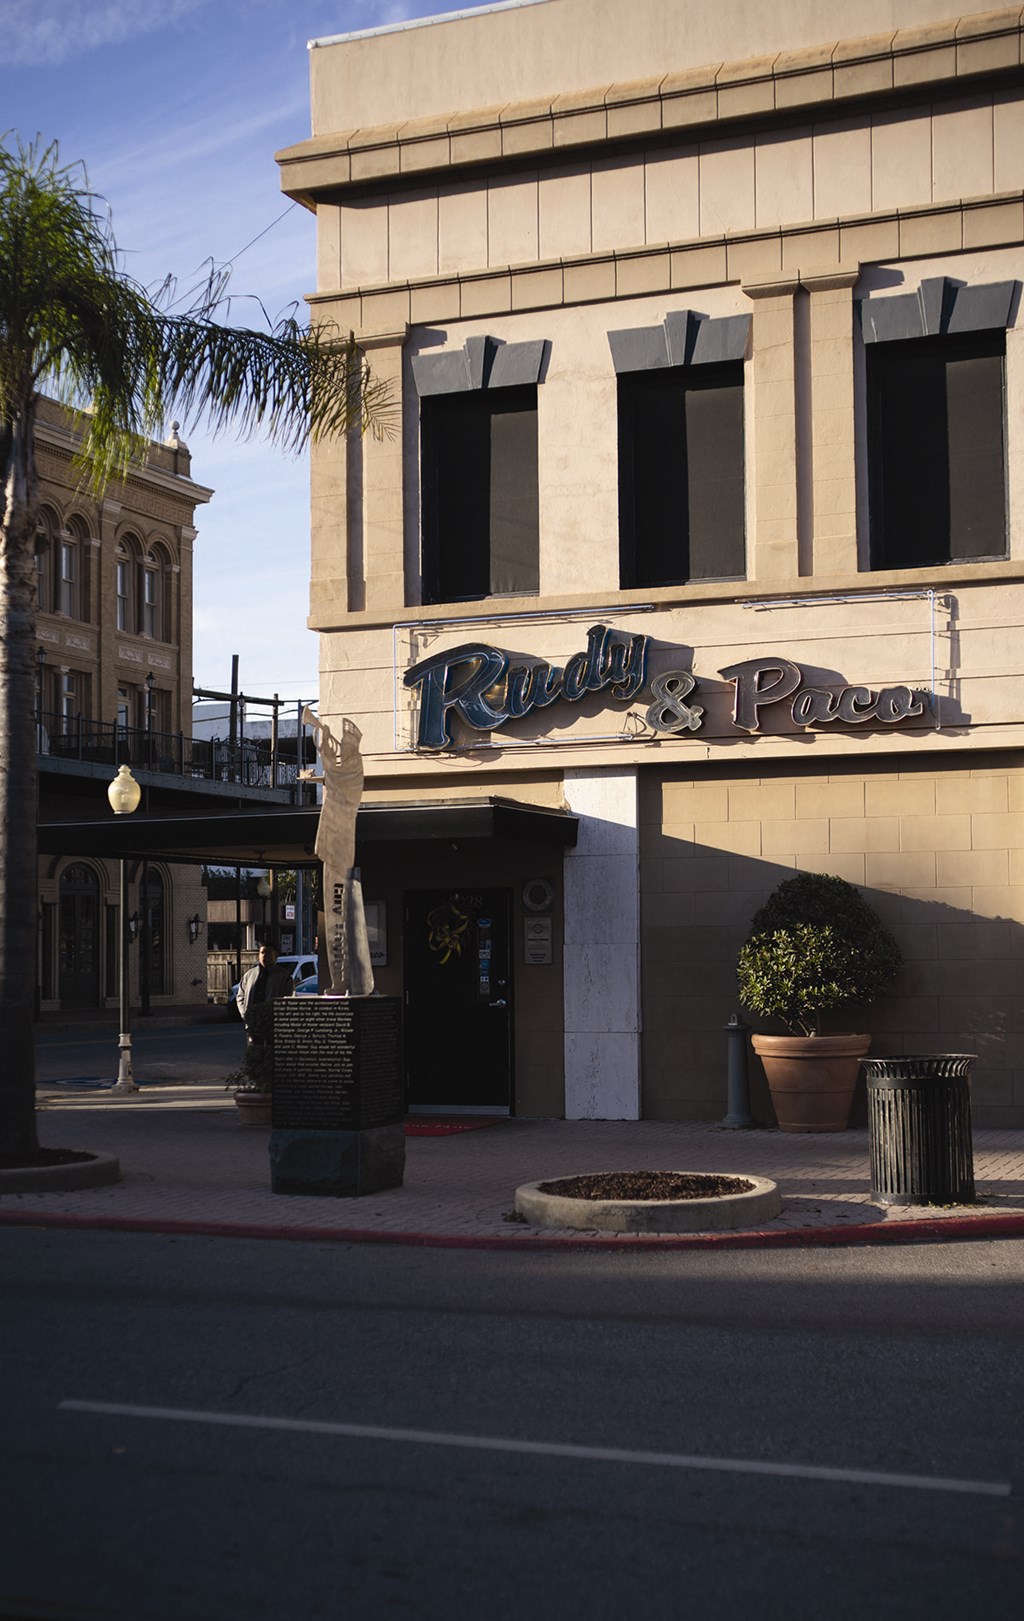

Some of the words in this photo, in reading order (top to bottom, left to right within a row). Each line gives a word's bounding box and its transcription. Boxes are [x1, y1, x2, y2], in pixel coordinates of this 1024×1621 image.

[403, 624, 650, 749] Rudy
[645, 669, 703, 735] &
[717, 656, 923, 731] Paco
[333, 882, 346, 917] Guy
[332, 922, 347, 984] Taylor
